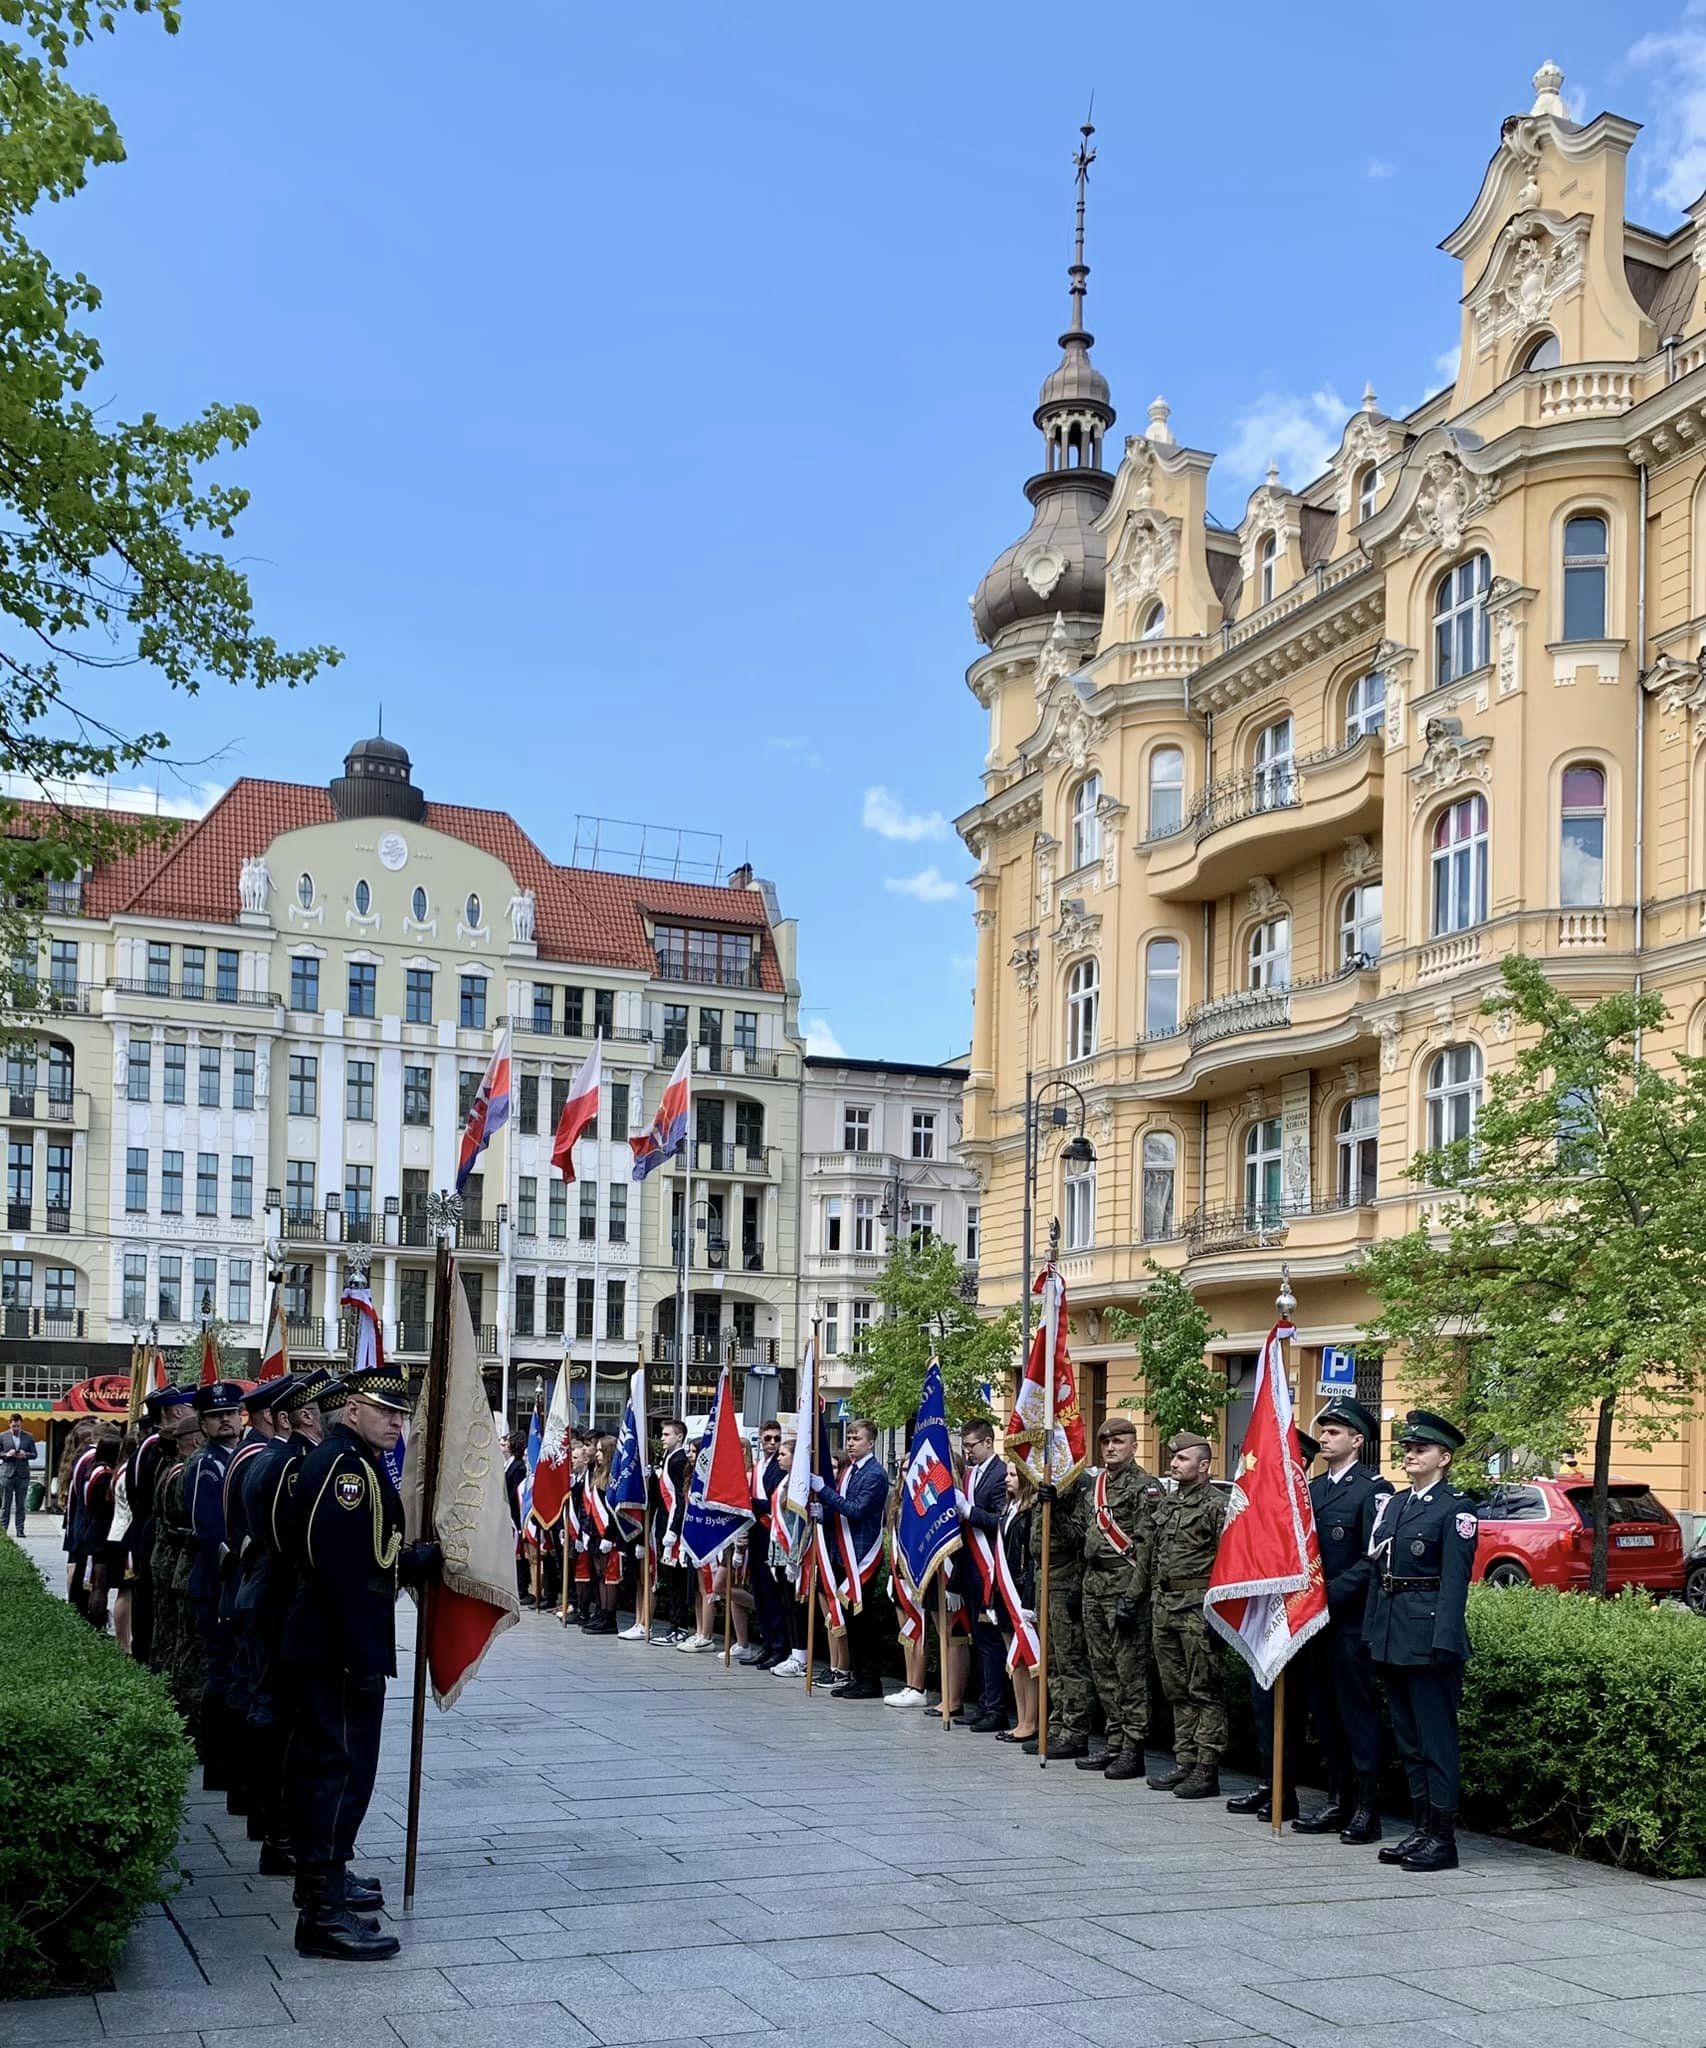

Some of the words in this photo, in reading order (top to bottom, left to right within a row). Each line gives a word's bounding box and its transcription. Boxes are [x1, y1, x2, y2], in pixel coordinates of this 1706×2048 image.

[1330, 1352, 1349, 1378] P
[1320, 1385, 1353, 1396] Koniec
[444, 1378, 493, 1568] BYDGOS
